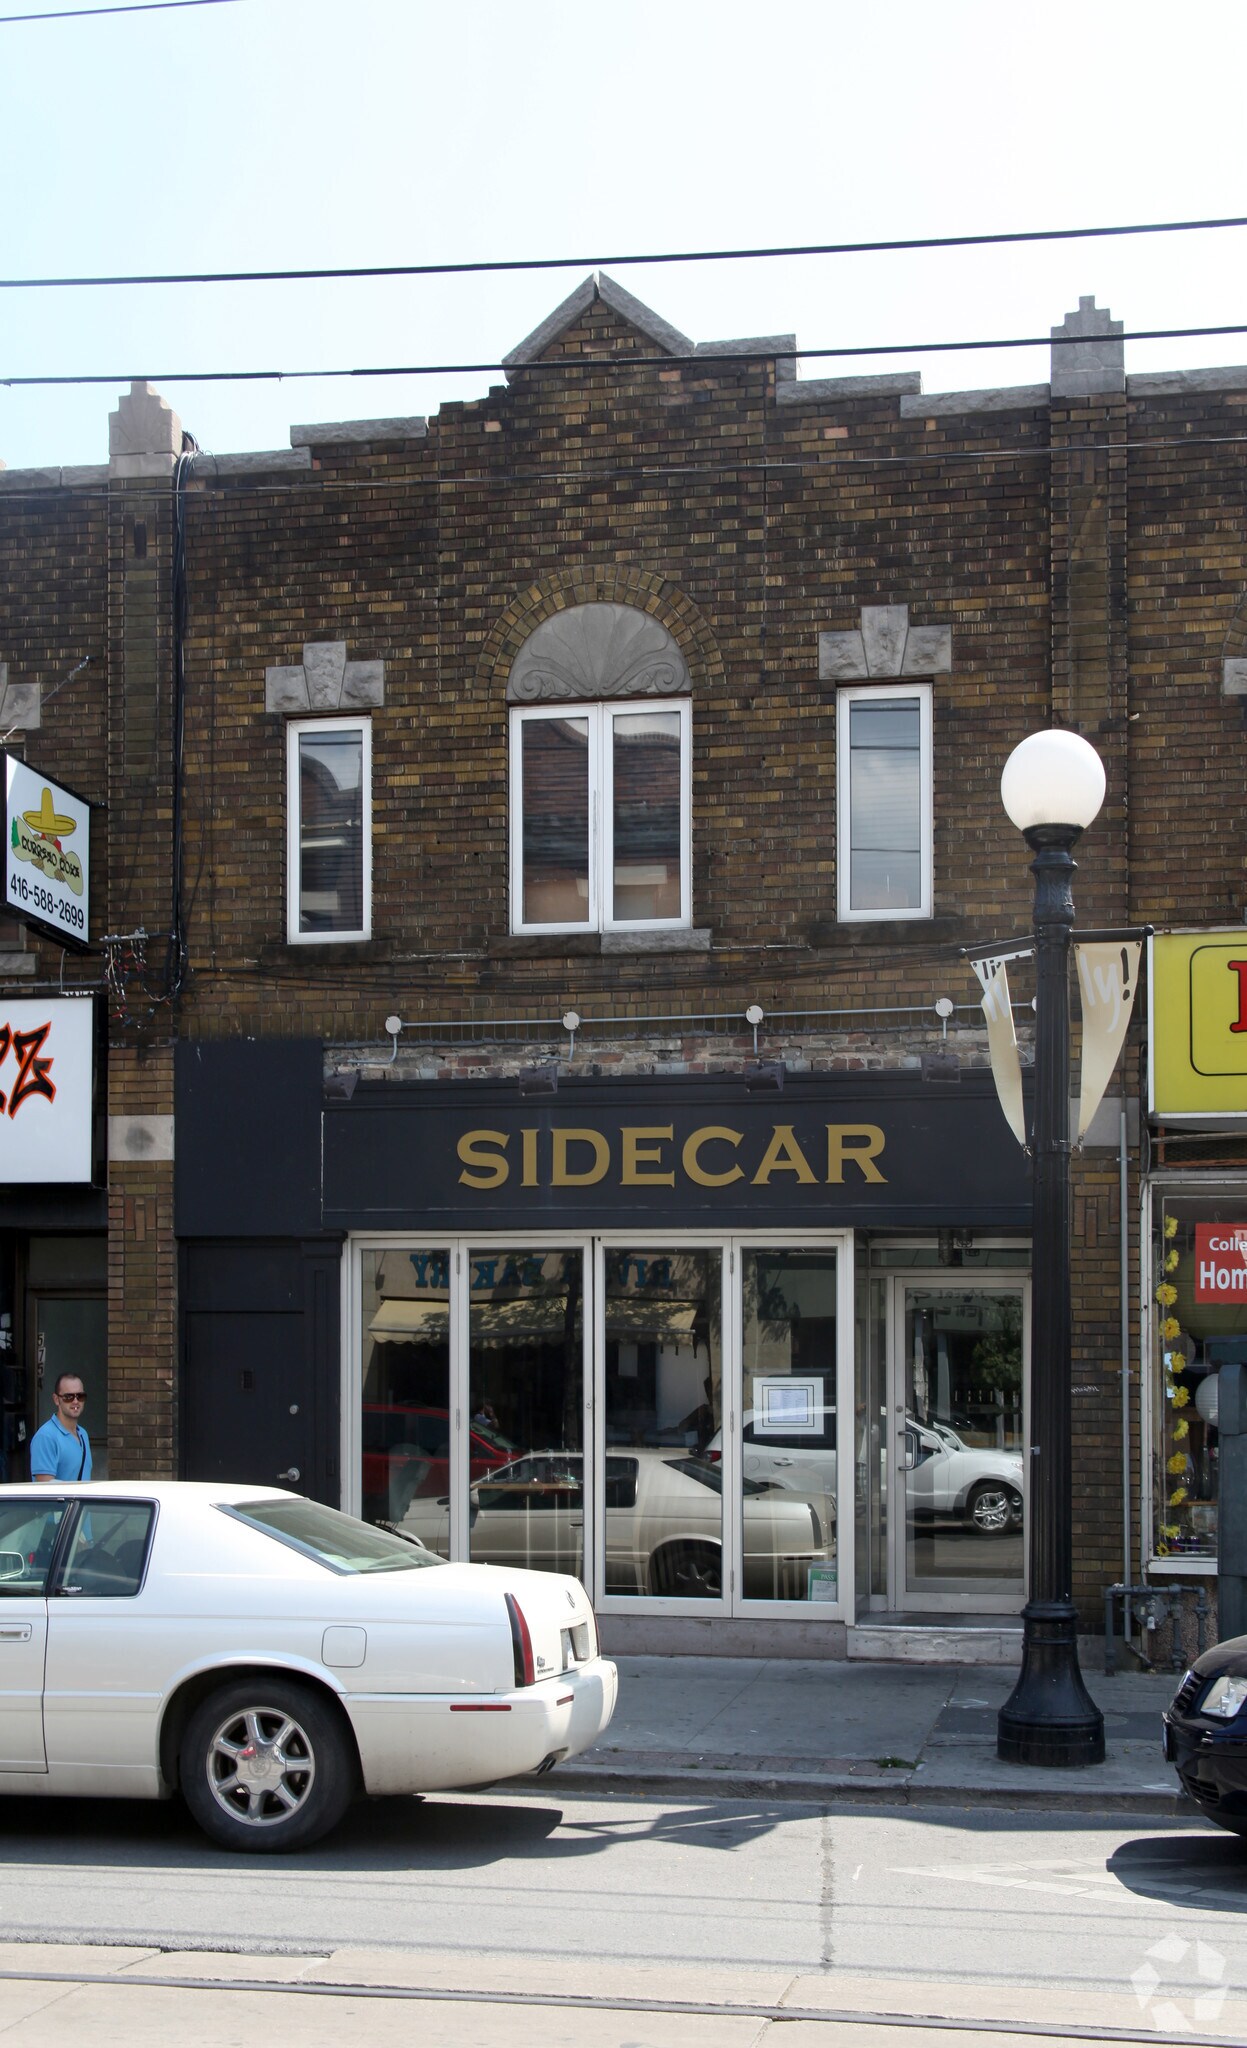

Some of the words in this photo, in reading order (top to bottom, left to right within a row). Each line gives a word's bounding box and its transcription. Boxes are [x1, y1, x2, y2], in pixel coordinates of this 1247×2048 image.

[10, 873, 84, 930] 416-588-2699
[457, 1123, 889, 1189] SIDECAR
[820, 1573, 835, 1581] PASS
